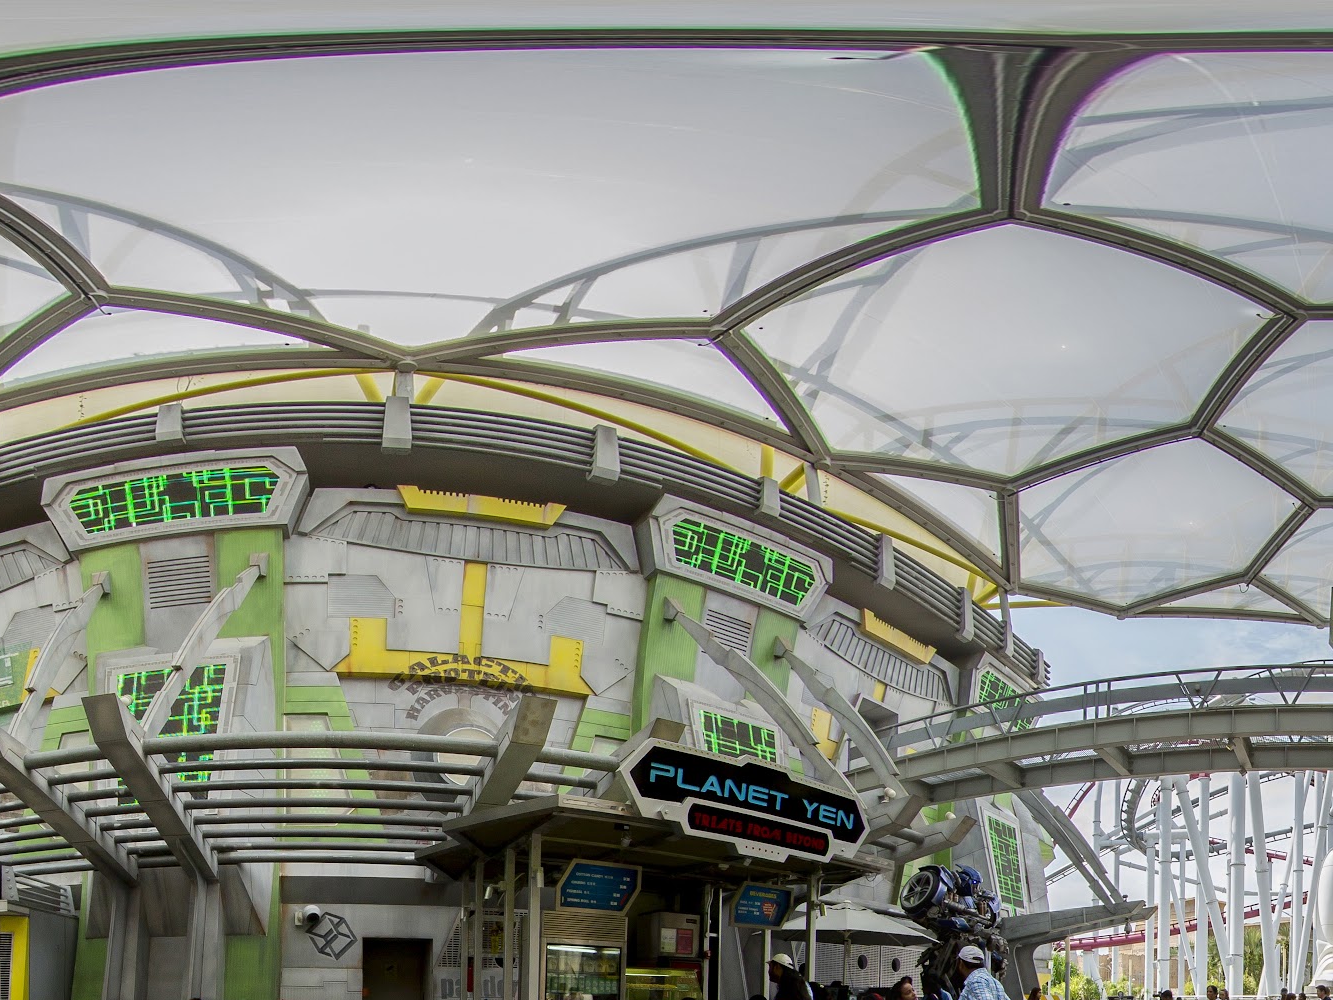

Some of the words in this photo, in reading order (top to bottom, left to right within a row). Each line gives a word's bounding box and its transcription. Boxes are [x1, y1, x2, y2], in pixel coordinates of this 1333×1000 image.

[649, 762, 789, 811] PLANET
[802, 799, 855, 830] YEN
[694, 812, 743, 834] TREATS
[746, 823, 782, 843] FROM
[785, 831, 826, 852] BEYOND
